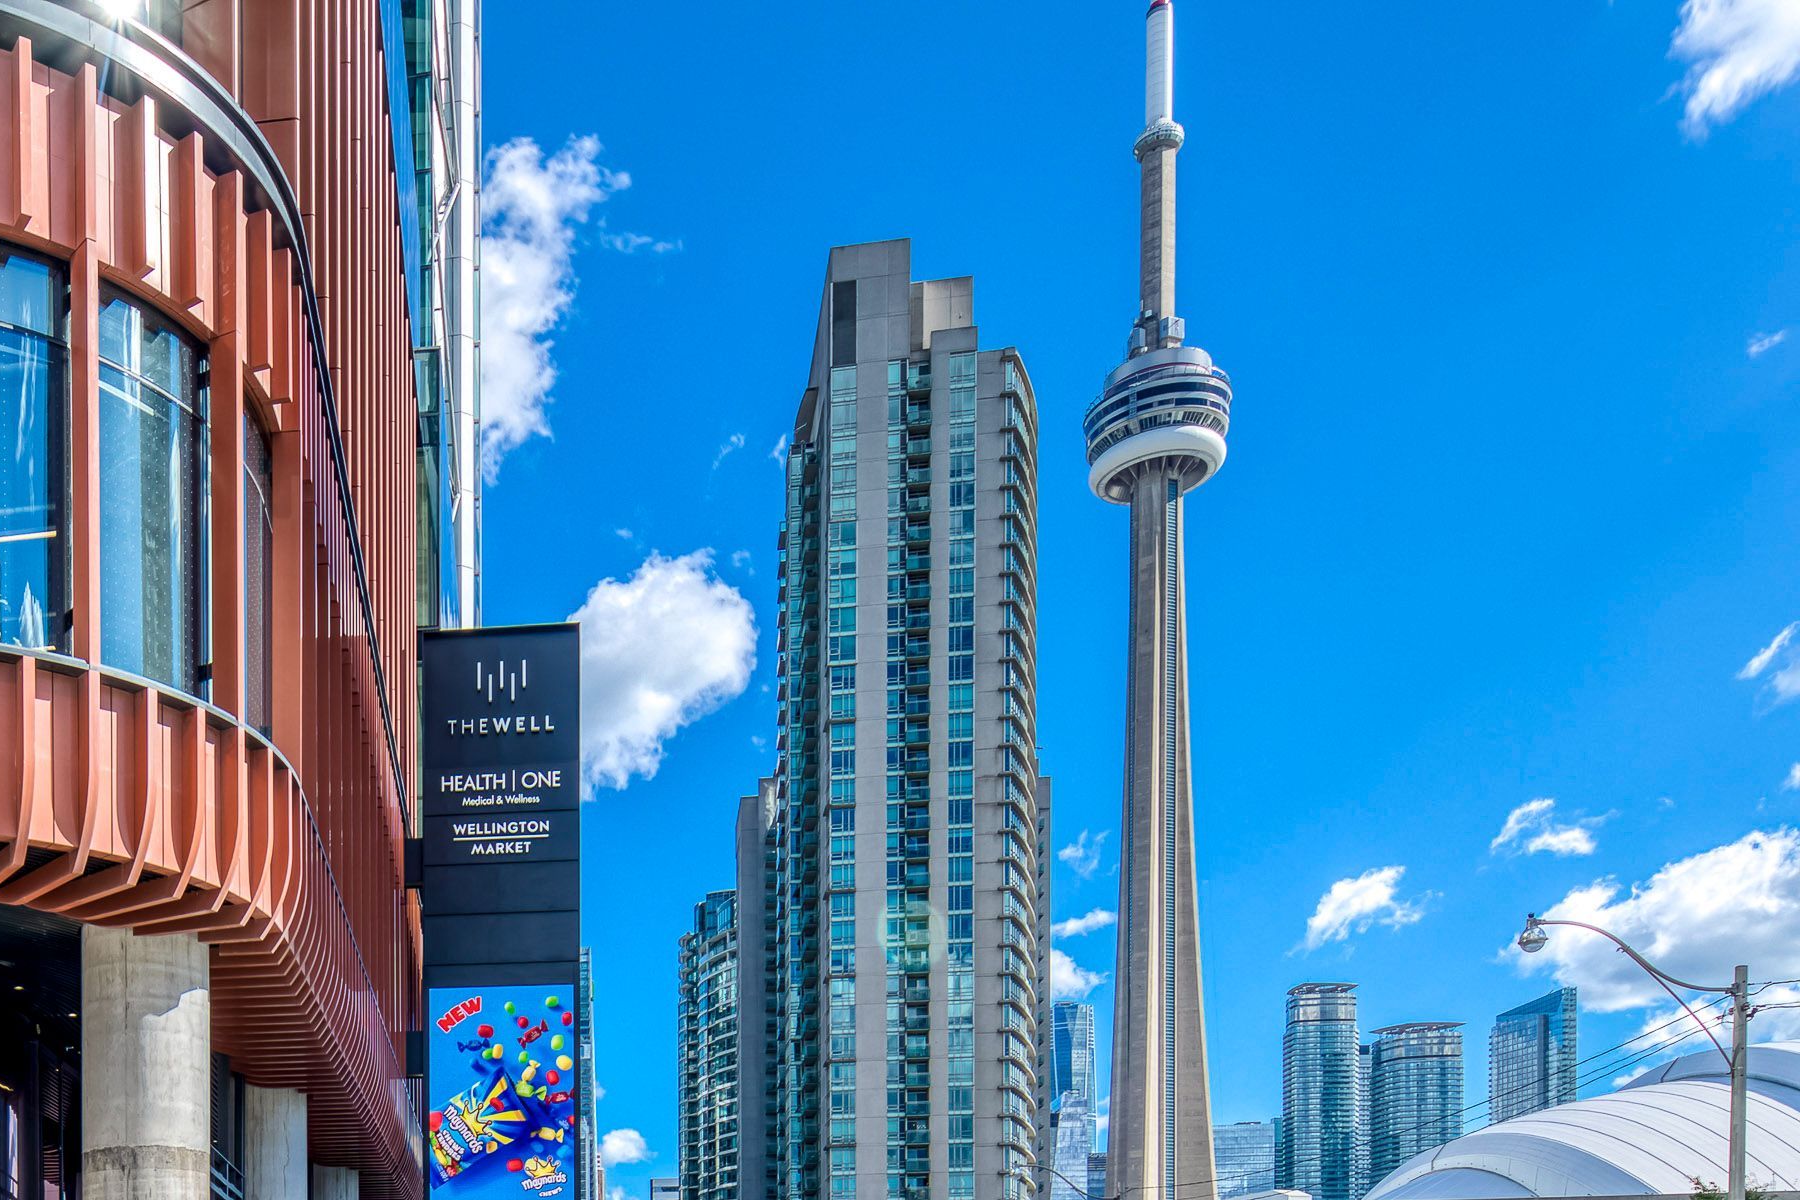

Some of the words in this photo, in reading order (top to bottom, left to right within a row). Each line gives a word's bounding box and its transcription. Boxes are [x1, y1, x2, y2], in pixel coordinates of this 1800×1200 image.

[440, 775, 506, 793] HEALTH
[521, 770, 561, 789] ONE
[462, 797, 495, 807] Medical
[496, 796, 503, 805] &
[505, 794, 540, 805] Wellness
[453, 820, 550, 836] WELLINGTON
[471, 841, 531, 855] MARKET
[436, 996, 482, 1034] NEW
